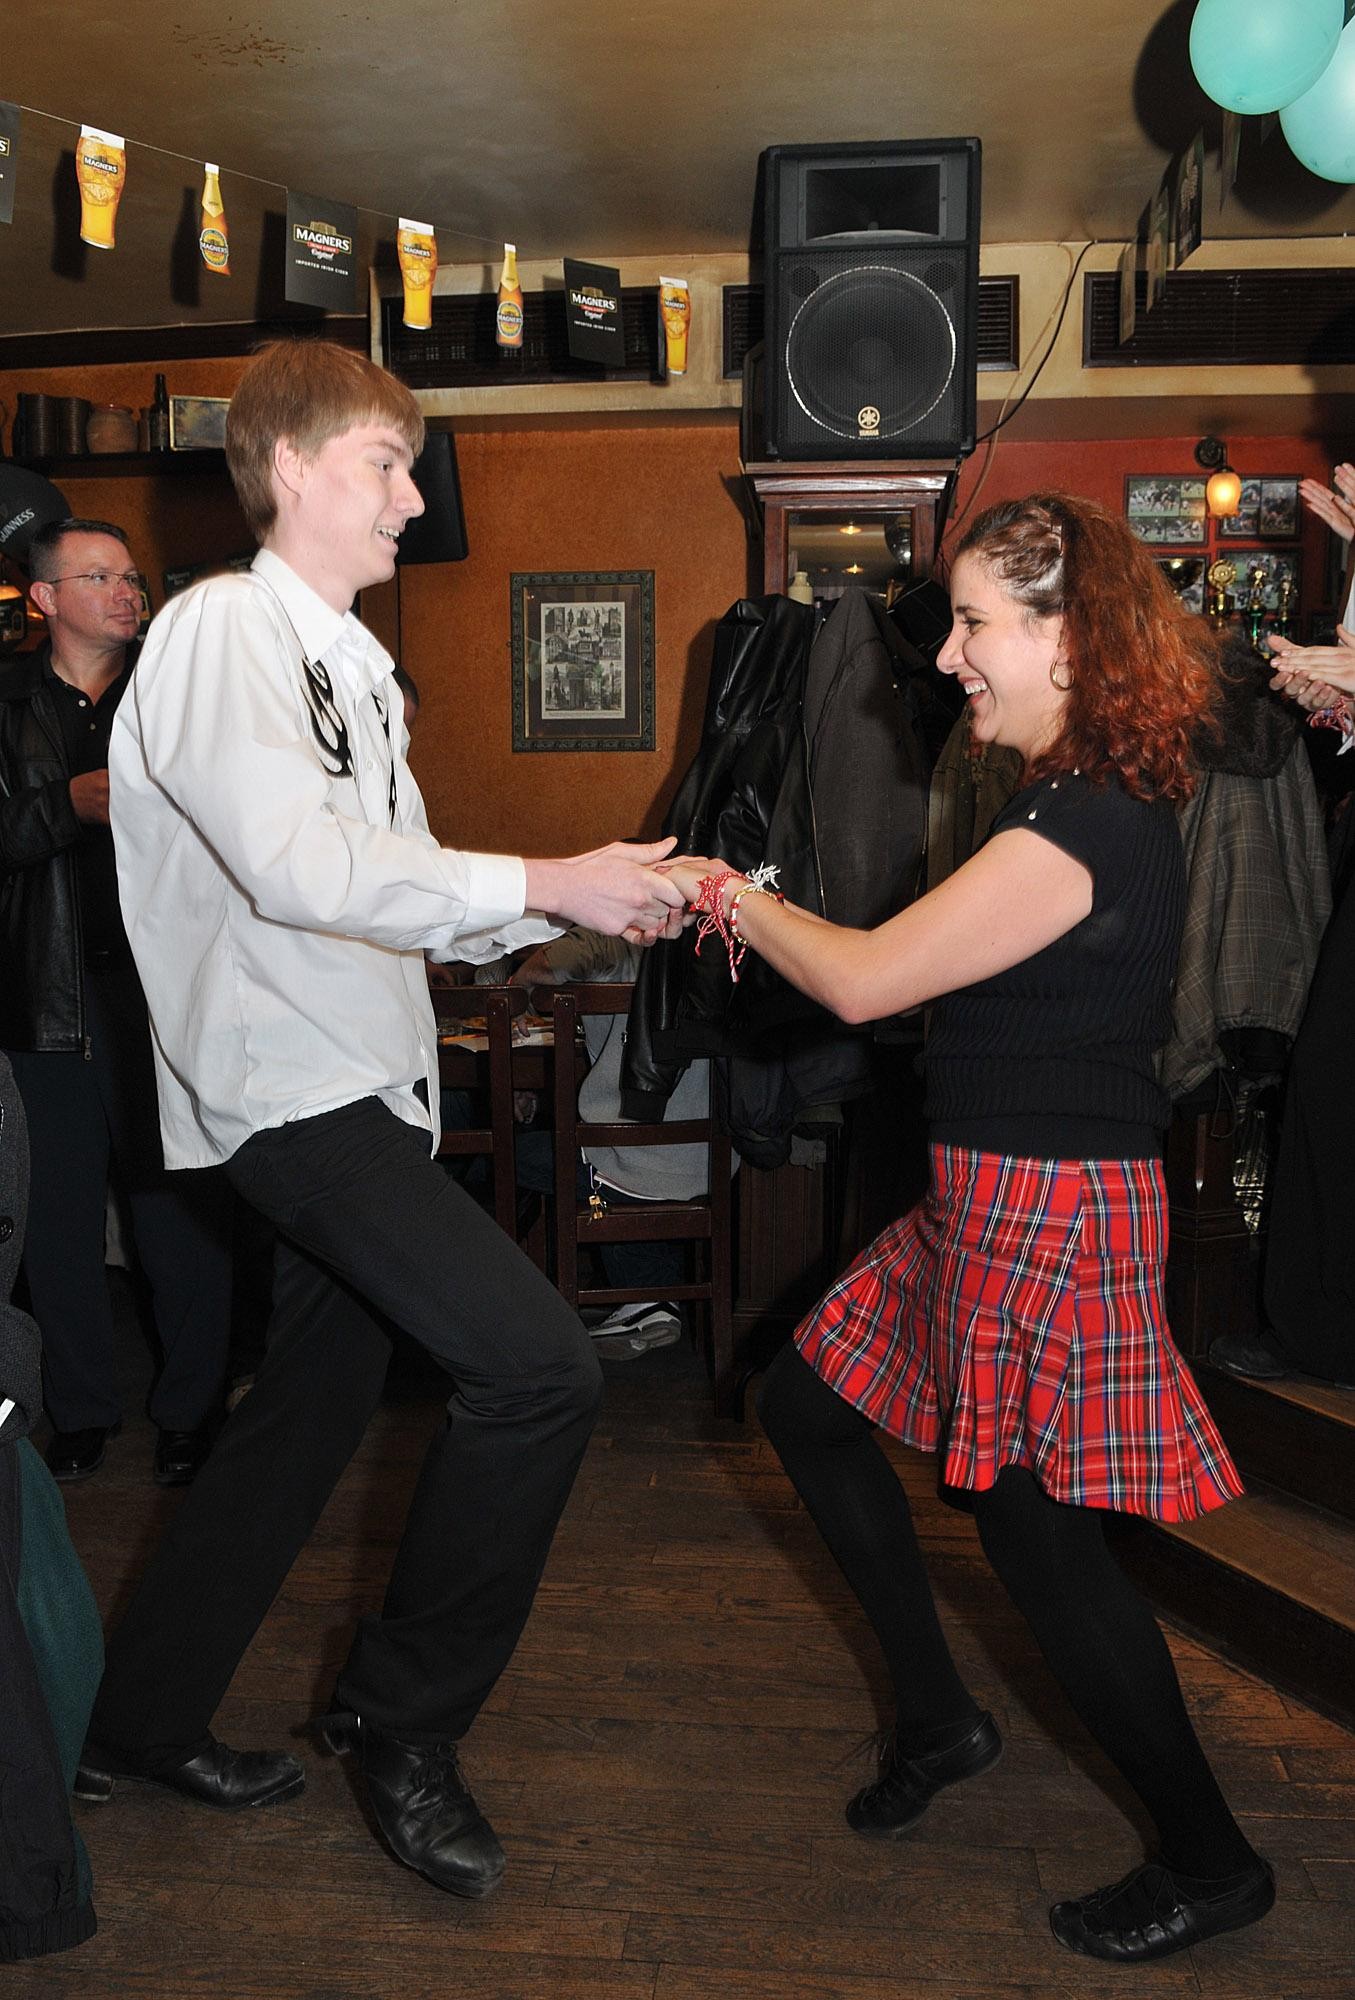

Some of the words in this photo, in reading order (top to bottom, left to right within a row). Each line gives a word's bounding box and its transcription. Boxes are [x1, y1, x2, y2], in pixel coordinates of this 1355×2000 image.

[84, 157, 117, 173] MAGNERS
[296, 228, 350, 251] MAGNERS
[295, 259, 320, 269] IMPORTED
[335, 268, 348, 276] CIDER
[572, 293, 616, 310] MAGNERS
